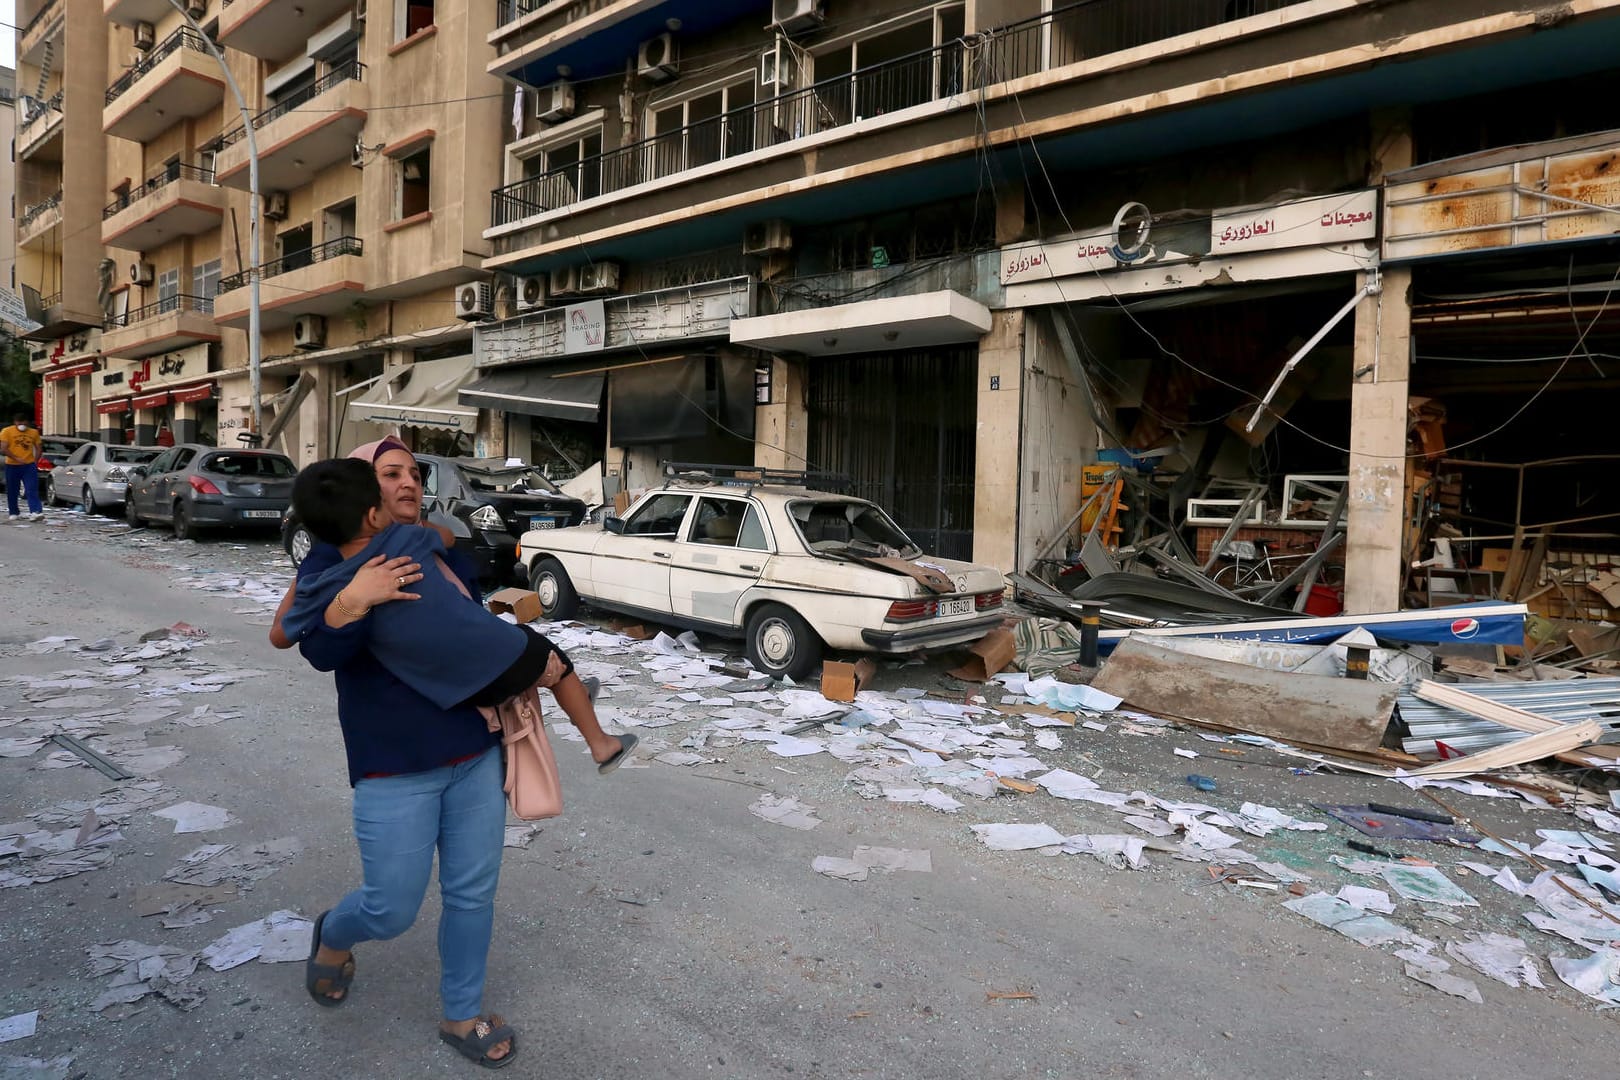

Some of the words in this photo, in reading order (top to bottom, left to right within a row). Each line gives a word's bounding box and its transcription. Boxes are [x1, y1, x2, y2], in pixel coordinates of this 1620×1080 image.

[1320, 210, 1373, 228] معجنات
[1219, 219, 1275, 246] العازوري
[1077, 244, 1108, 259] عجنات
[1006, 252, 1046, 278] العازوري
[572, 322, 601, 332] TRADING
